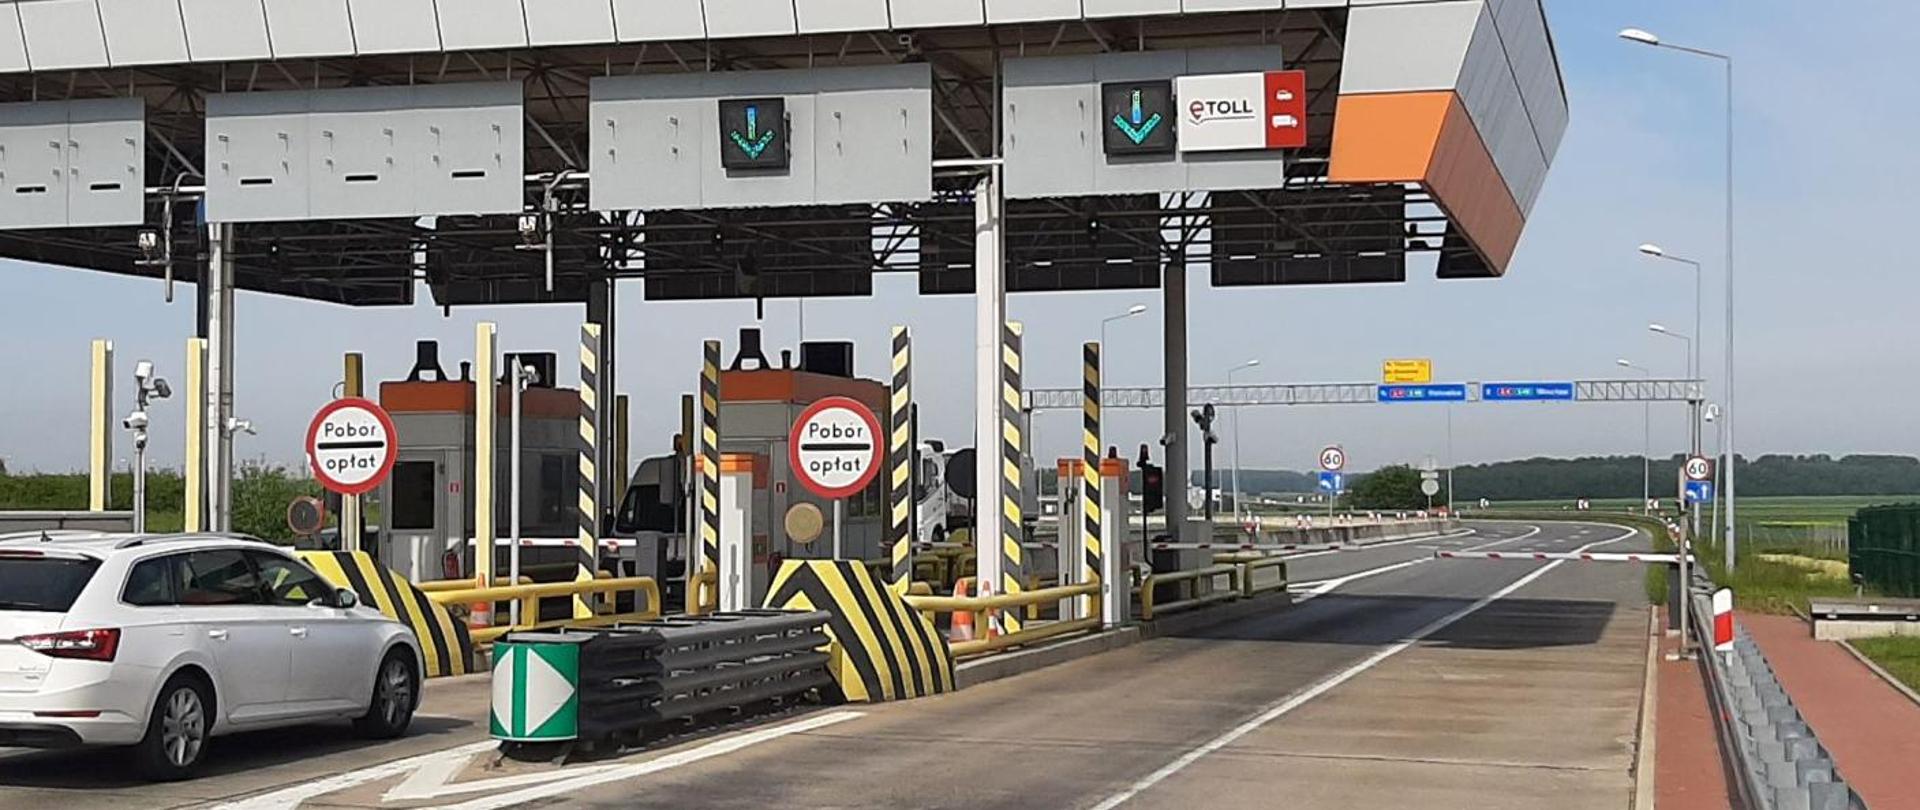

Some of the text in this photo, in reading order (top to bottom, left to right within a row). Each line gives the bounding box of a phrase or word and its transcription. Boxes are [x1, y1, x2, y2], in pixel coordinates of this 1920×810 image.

[1189, 99, 1253, 120] eTOLL
[809, 422, 863, 438] Pobór
[326, 453, 376, 473] opłat
[810, 456, 860, 477] opłat
[1324, 453, 1340, 464] 60
[1689, 462, 1706, 474] 60
